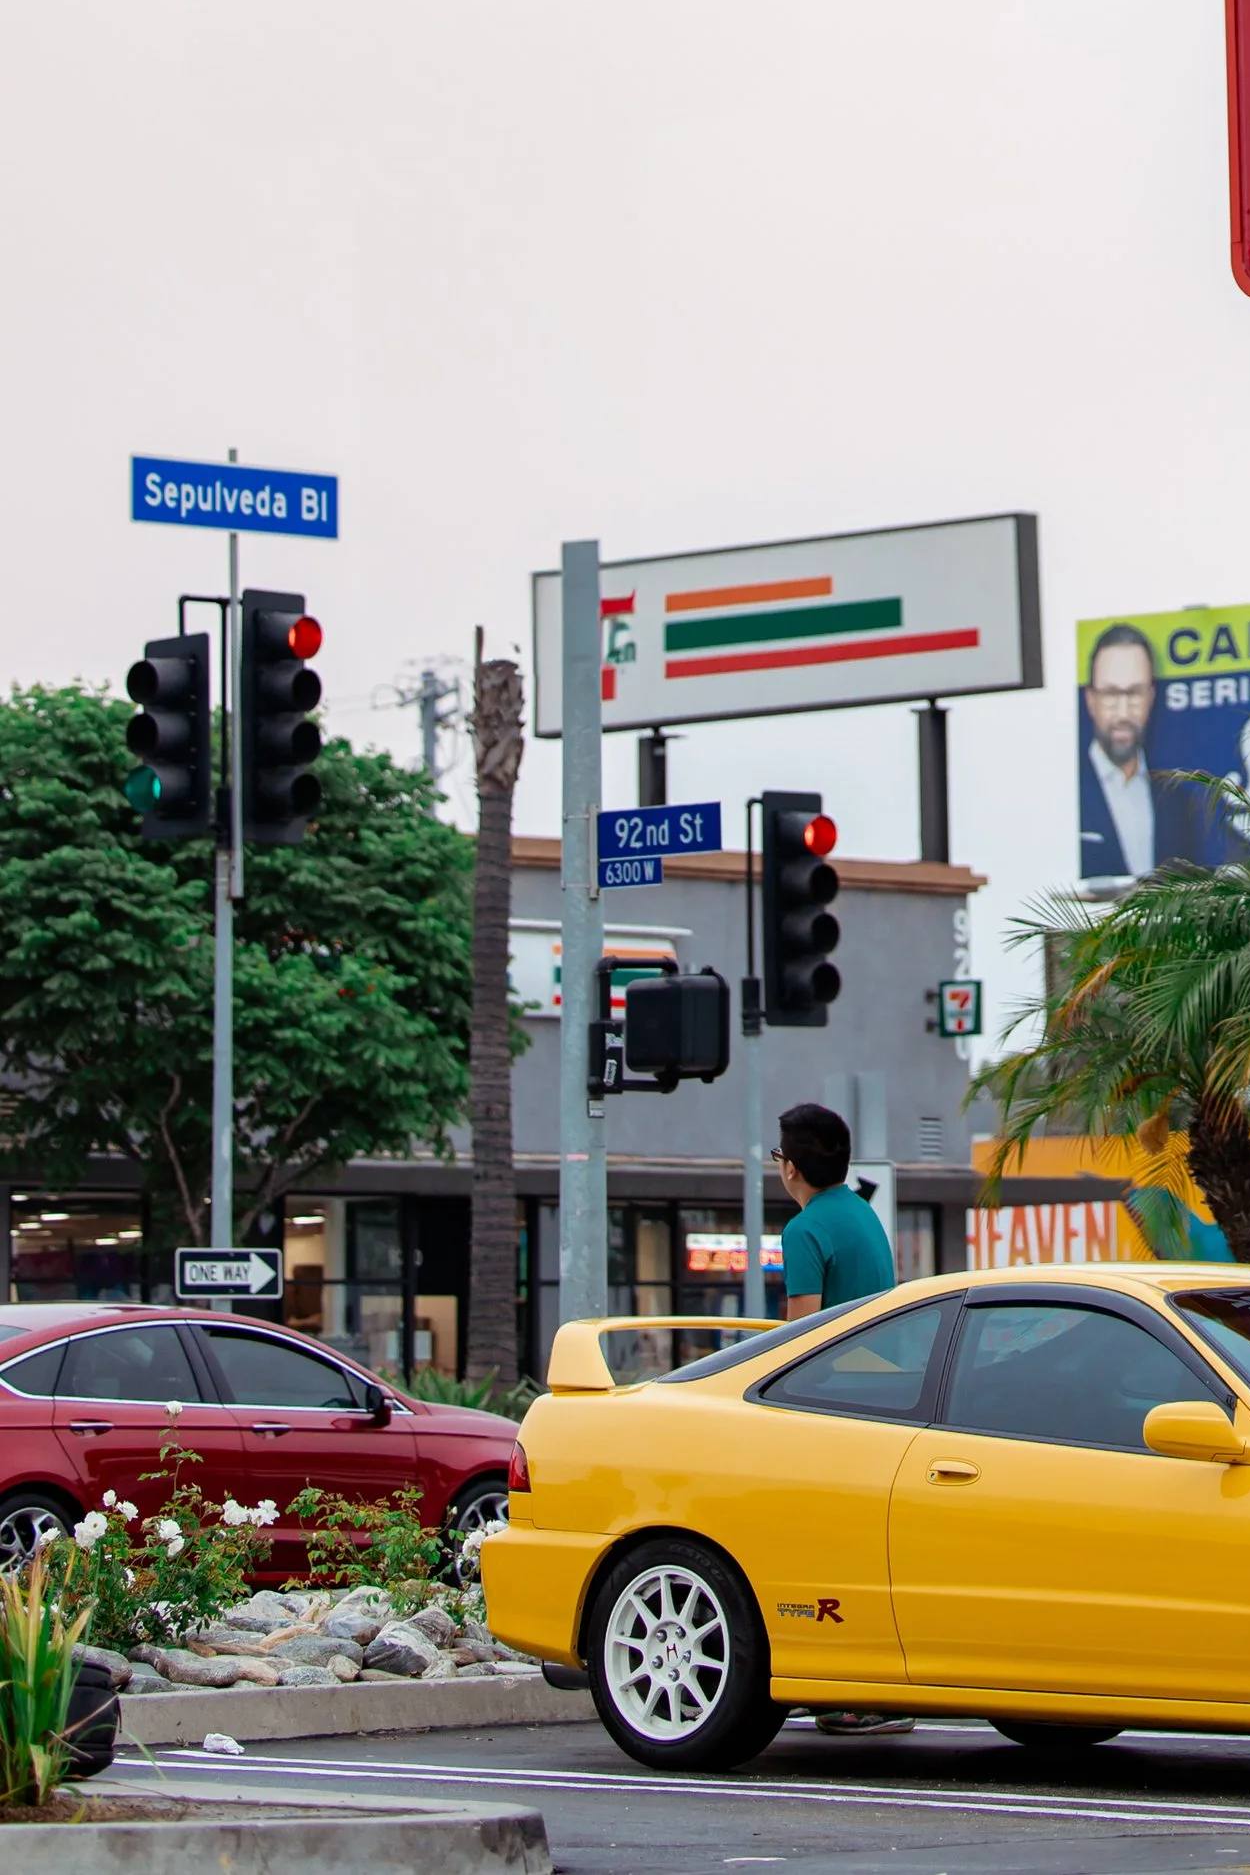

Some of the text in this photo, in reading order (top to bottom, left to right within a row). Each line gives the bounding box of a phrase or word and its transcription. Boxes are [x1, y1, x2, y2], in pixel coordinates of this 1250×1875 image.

[145, 472, 287, 518] Sepulveda
[615, 812, 703, 848] 92nd St
[605, 860, 655, 884] 6300 W
[189, 1264, 250, 1282] ONE WAY
[816, 1598, 845, 1623] R
